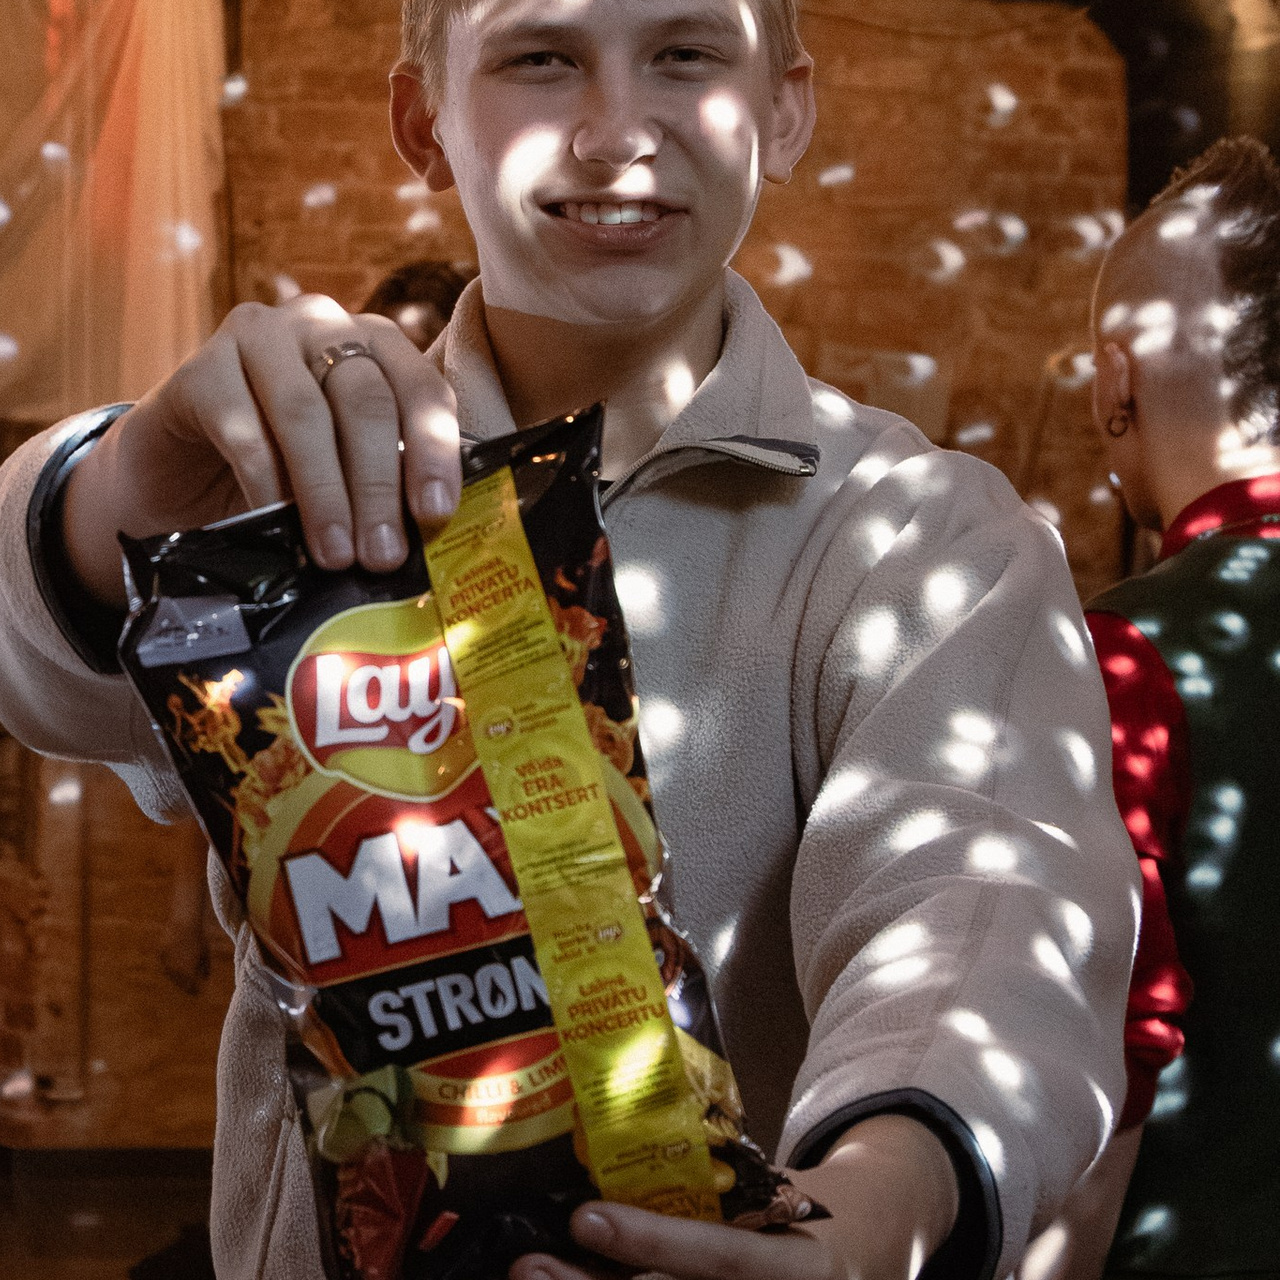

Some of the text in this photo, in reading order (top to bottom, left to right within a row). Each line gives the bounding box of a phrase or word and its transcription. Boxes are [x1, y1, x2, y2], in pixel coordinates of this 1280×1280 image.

[501, 783, 599, 823] KONTSERT
[523, 774, 565, 797] ERA
[284, 806, 524, 965] MA
[368, 955, 551, 1052] STRON
